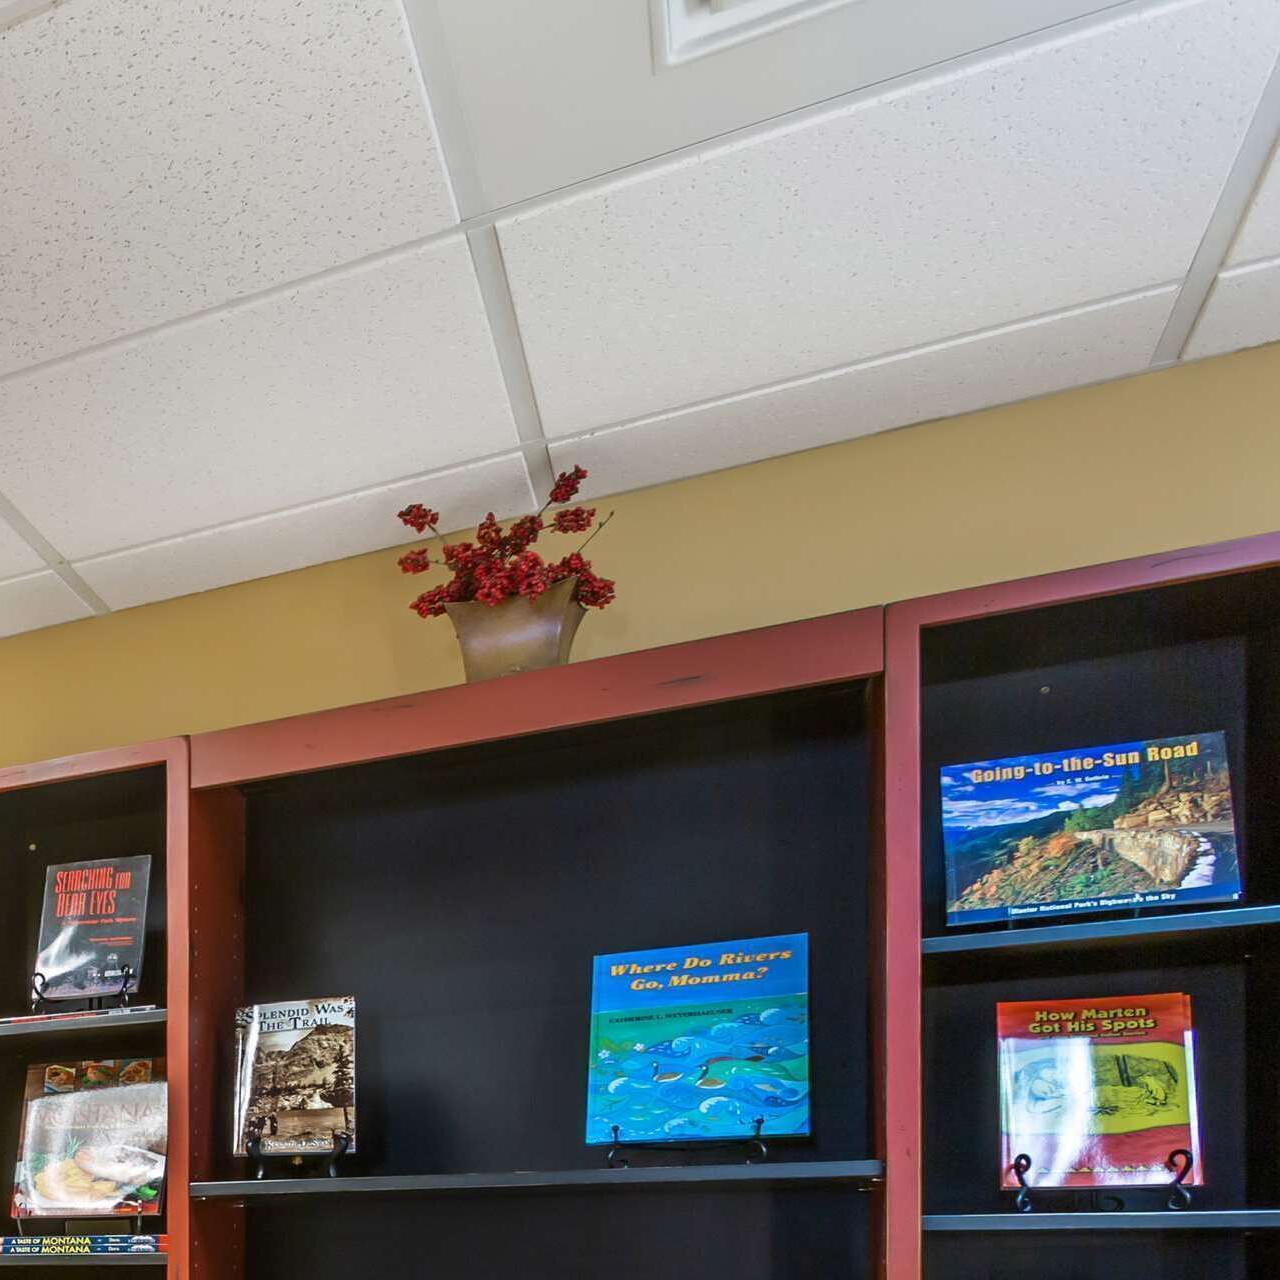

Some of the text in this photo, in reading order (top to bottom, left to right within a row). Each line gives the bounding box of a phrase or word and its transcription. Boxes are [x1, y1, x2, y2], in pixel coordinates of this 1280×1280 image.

[971, 740, 1200, 784] Going-to-the-Sun Road
[55, 867, 131, 893] SEARCHING FOR
[90, 890, 116, 915] EYES
[1040, 903, 1072, 911] National
[1074, 900, 1098, 908] Park's
[1161, 892, 1176, 900] Sky
[610, 950, 793, 977] Where Do Rivers
[630, 966, 769, 991] Go, Momma?
[1035, 1007, 1147, 1021] How Marten
[1028, 1018, 1156, 1034] Got His Spots
[11, 1237, 16, 1245] A
[17, 1237, 32, 1245] TASTE
[42, 1236, 91, 1246] MONTANA
[16, 1245, 31, 1253] TASTE
[41, 1245, 91, 1254] MONTANA
